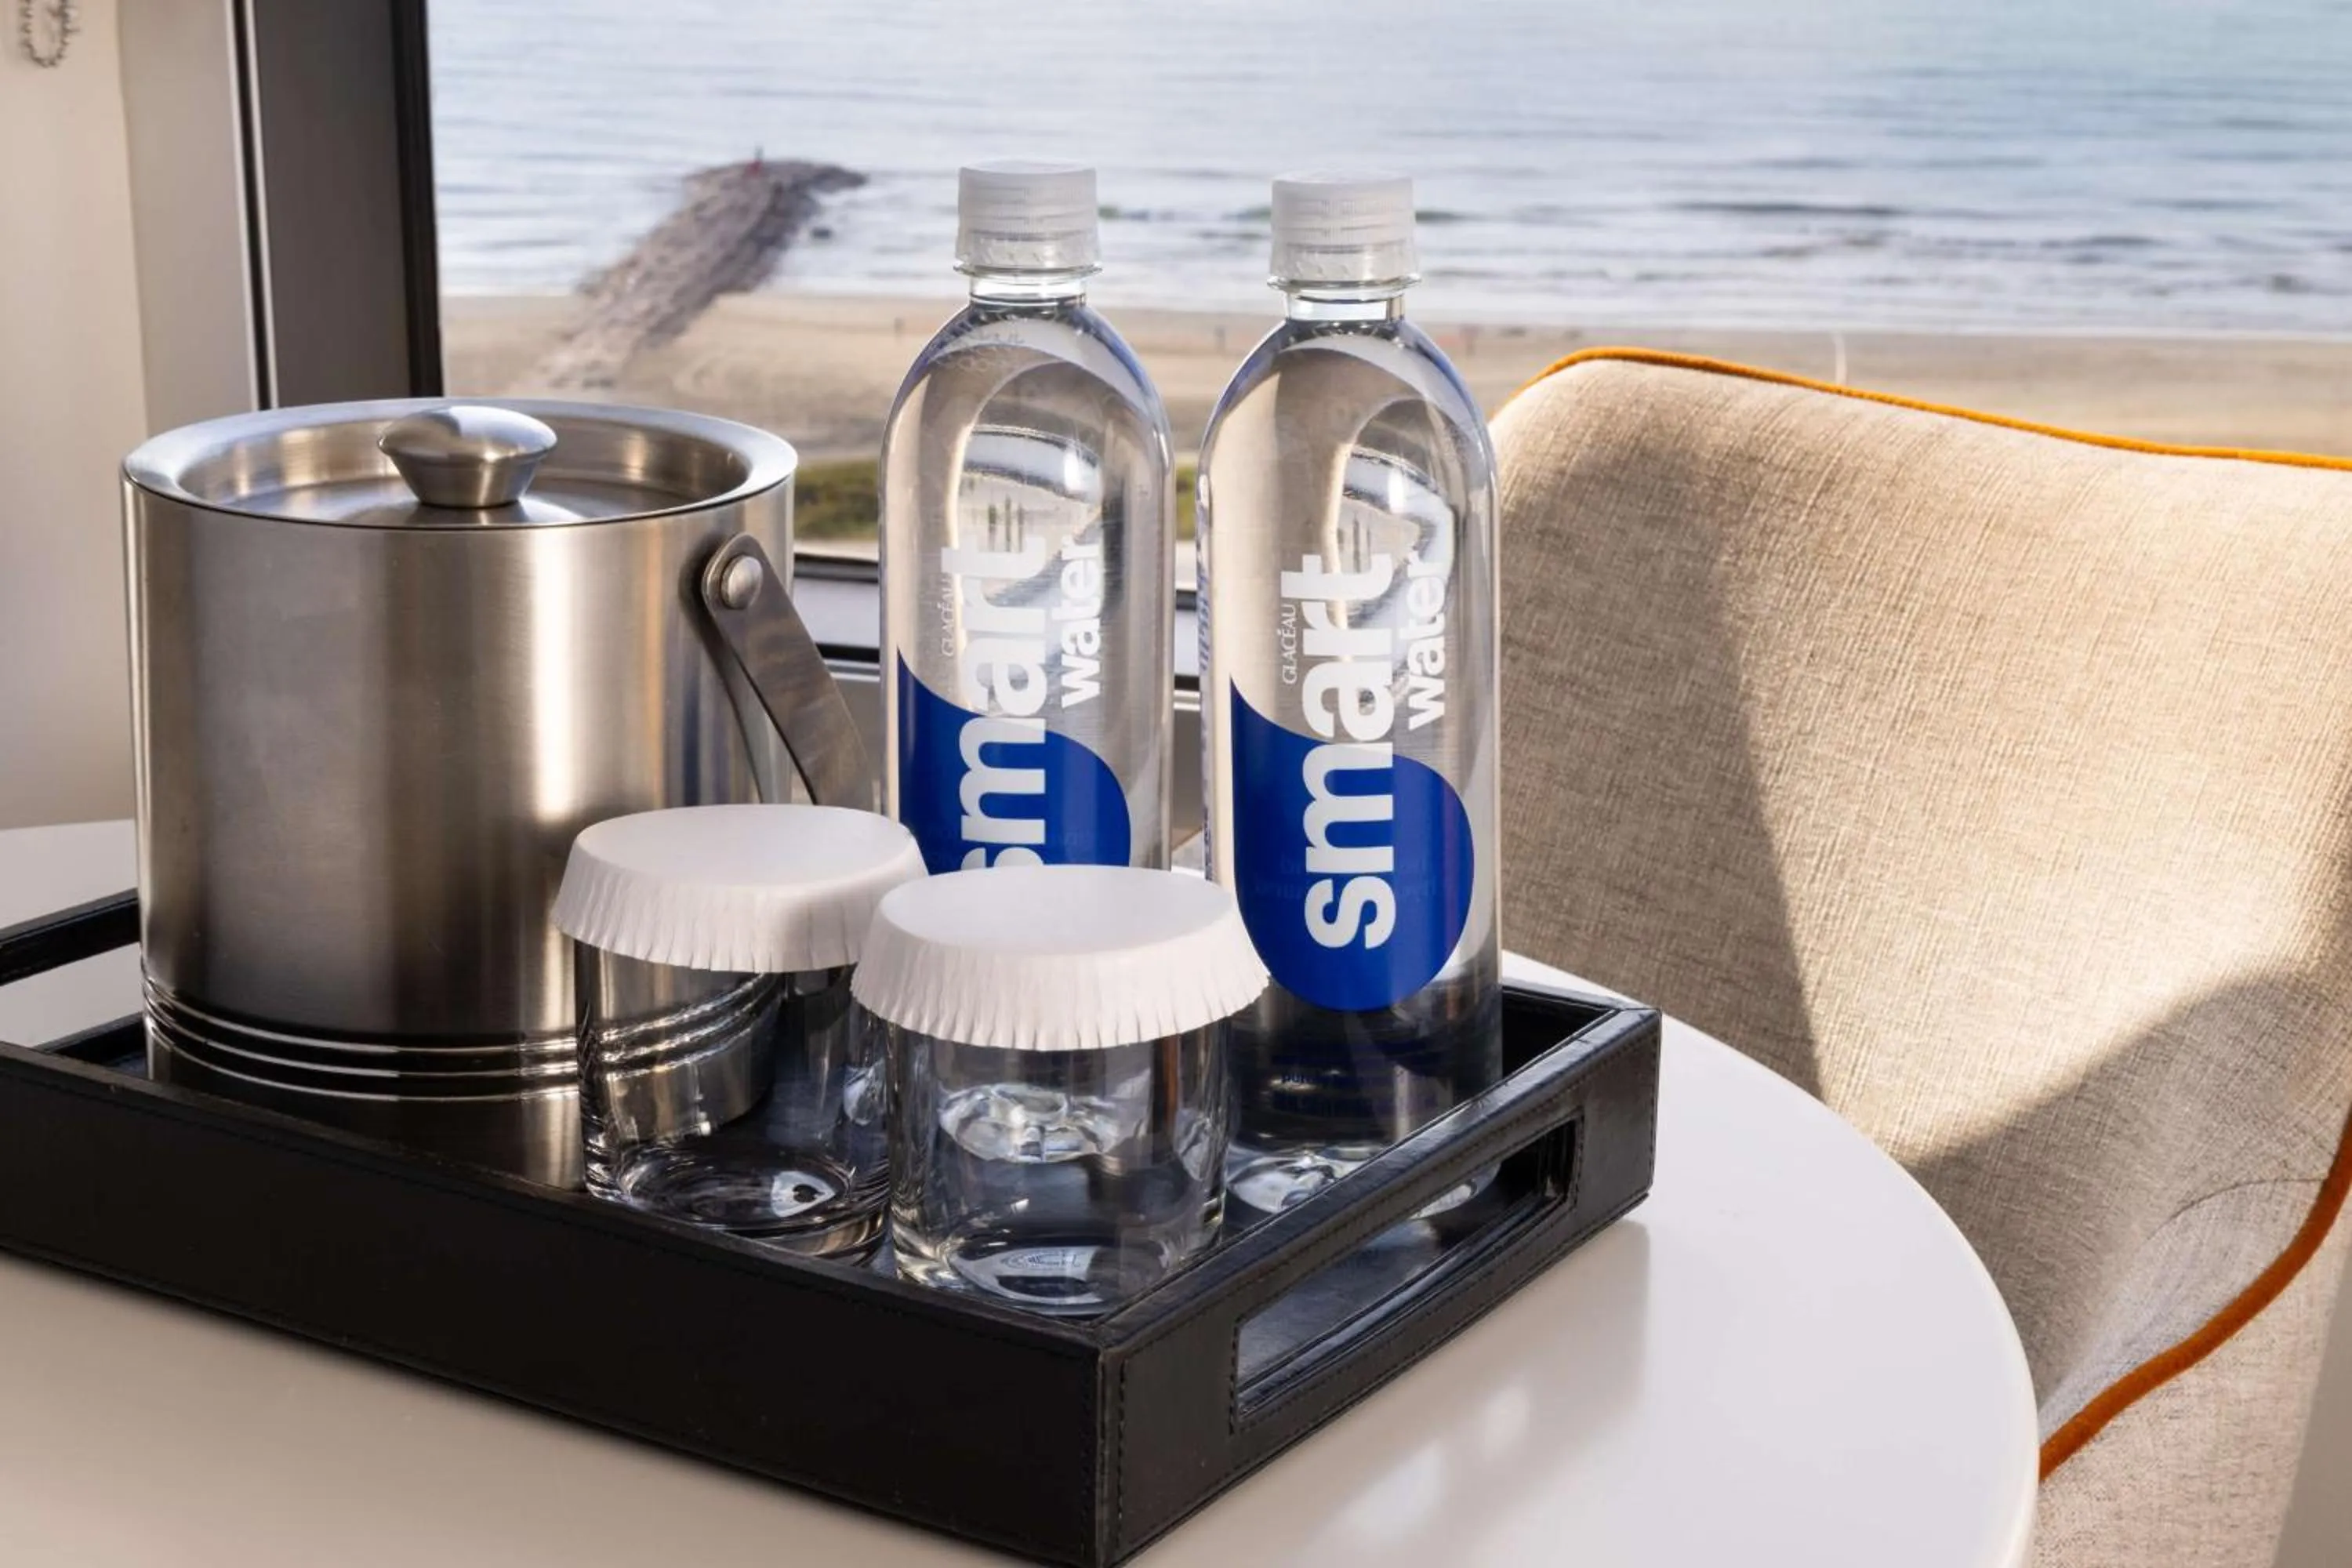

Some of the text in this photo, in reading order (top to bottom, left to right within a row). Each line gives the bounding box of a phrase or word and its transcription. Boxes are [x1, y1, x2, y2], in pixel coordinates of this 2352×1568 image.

[941, 535, 1047, 868] mart
[1051, 535, 1102, 709] water
[1278, 604, 1298, 685] GLACÉAU
[1399, 550, 1446, 731] water
[1281, 553, 1396, 949] smart
